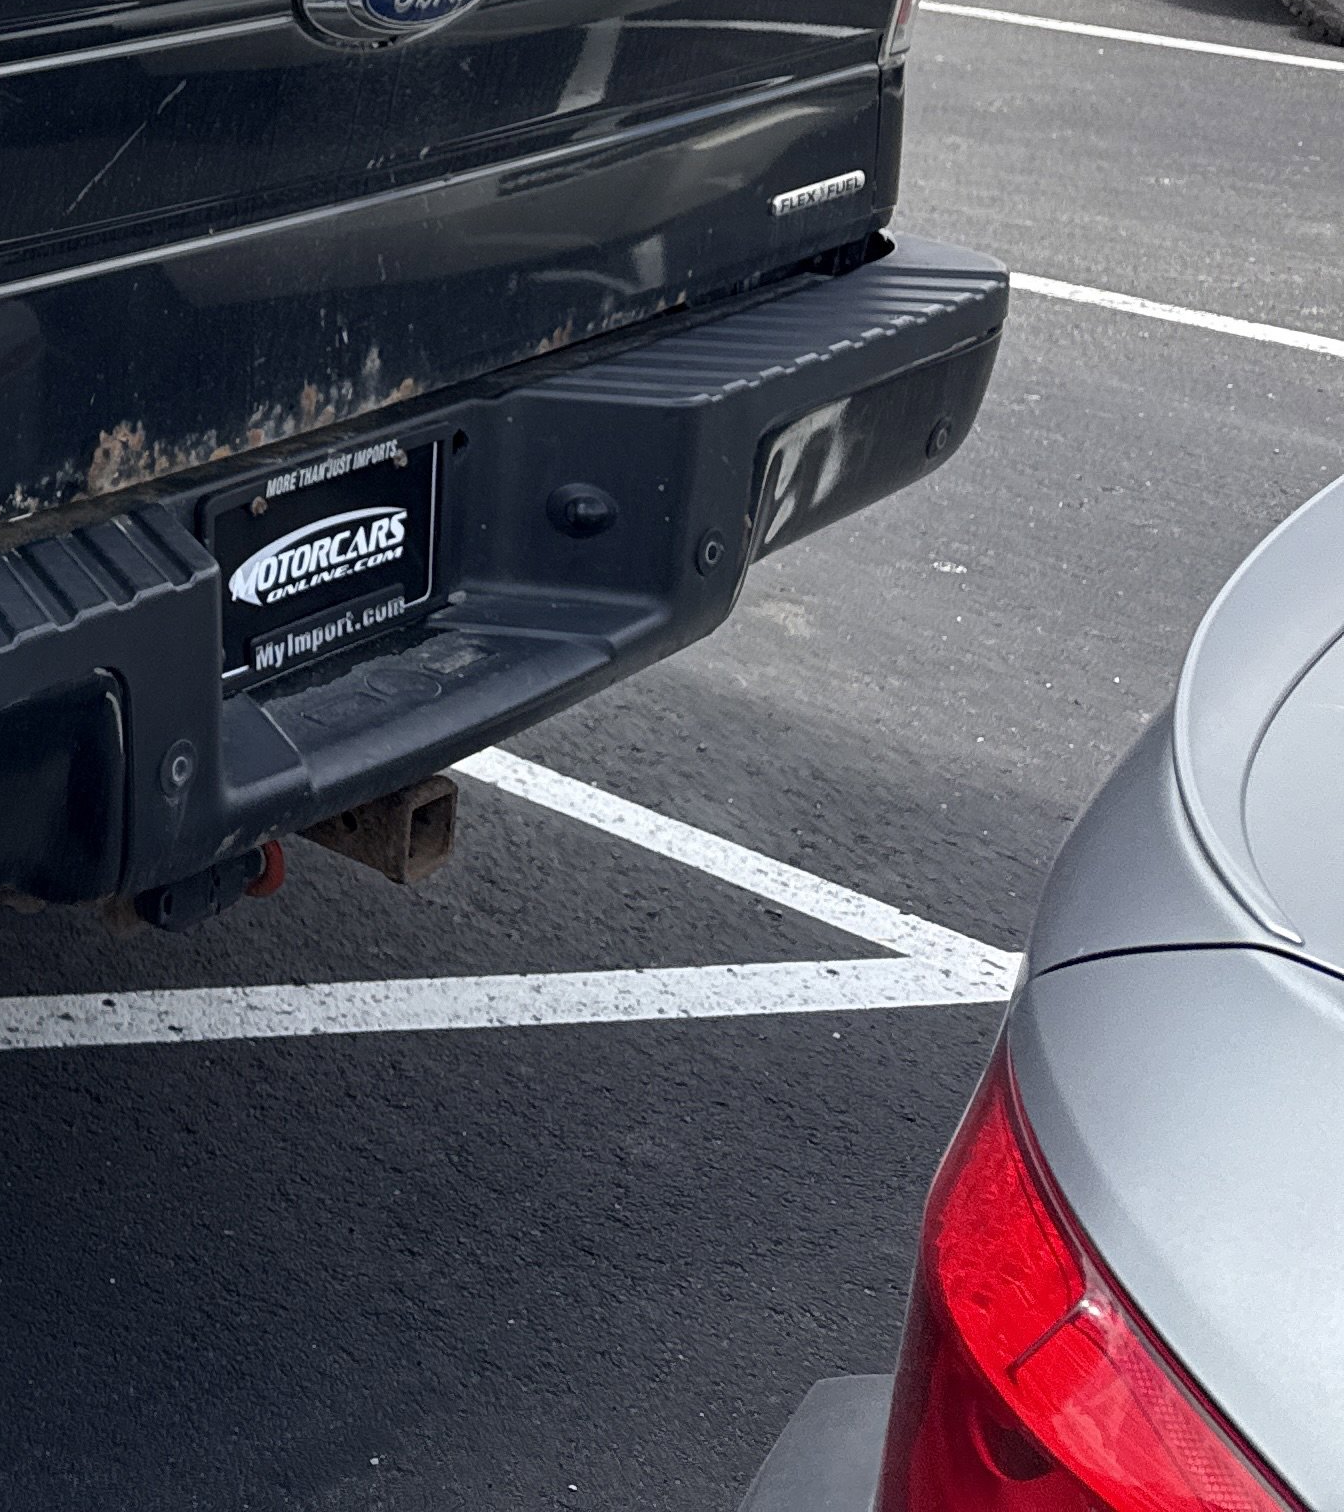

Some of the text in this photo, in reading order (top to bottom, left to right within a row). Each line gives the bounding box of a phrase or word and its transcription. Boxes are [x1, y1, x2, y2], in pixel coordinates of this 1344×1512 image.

[780, 175, 862, 214] FLEX FUEL
[265, 438, 398, 499] MORE THAN JUST IMPORTS
[230, 510, 408, 603] MOTORCARS
[266, 545, 404, 604] ONLINE.COM
